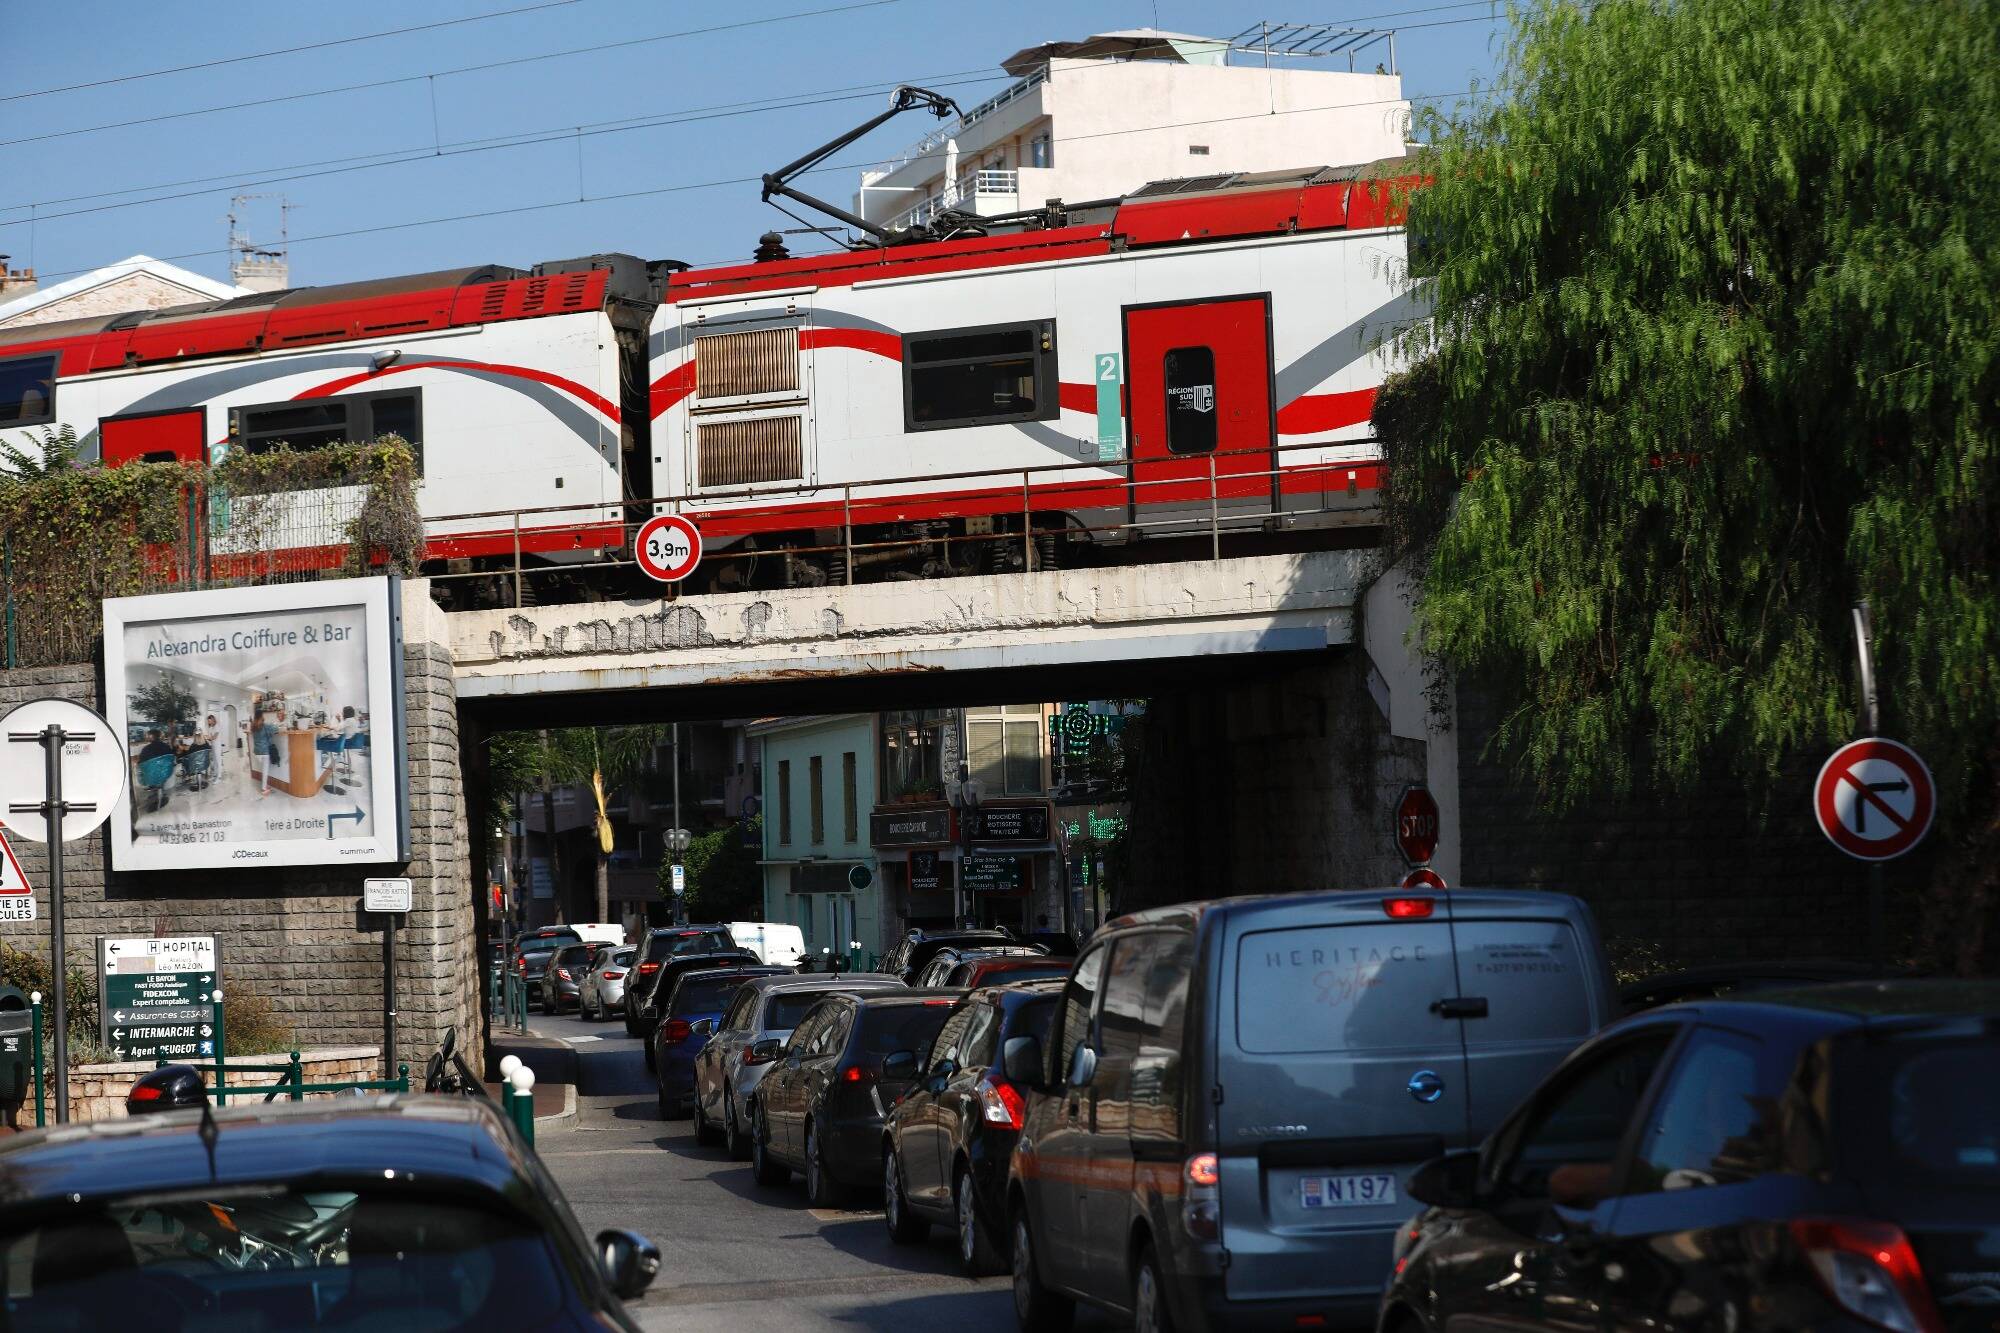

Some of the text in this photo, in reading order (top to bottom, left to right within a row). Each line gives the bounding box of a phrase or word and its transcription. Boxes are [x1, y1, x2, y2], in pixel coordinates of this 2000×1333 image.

[1100, 356, 1116, 381] 2
[1168, 386, 1193, 395] RÉGION
[648, 540, 688, 559] 3,9m
[147, 623, 351, 658] Alexandra Coiffure & Bar
[181, 821, 191, 830] du
[265, 817, 325, 831] 1ère à Droite
[1402, 815, 1433, 837] STOP
[182, 832, 197, 844] 86
[199, 832, 210, 843] 21
[213, 831, 225, 842] 03
[232, 849, 269, 859] JCDecaux
[17, 899, 30, 908] DE
[163, 941, 211, 952] HOPITAL
[1266, 945, 1427, 968] HERITAGE
[143, 990, 178, 998] FIDEXCOM
[132, 997, 190, 1008] Expert comptable
[130, 1012, 178, 1021] Assurances
[130, 1026, 195, 1039] INTERMARCHE
[131, 1046, 155, 1058] Agent
[1328, 1176, 1389, 1200] N197
